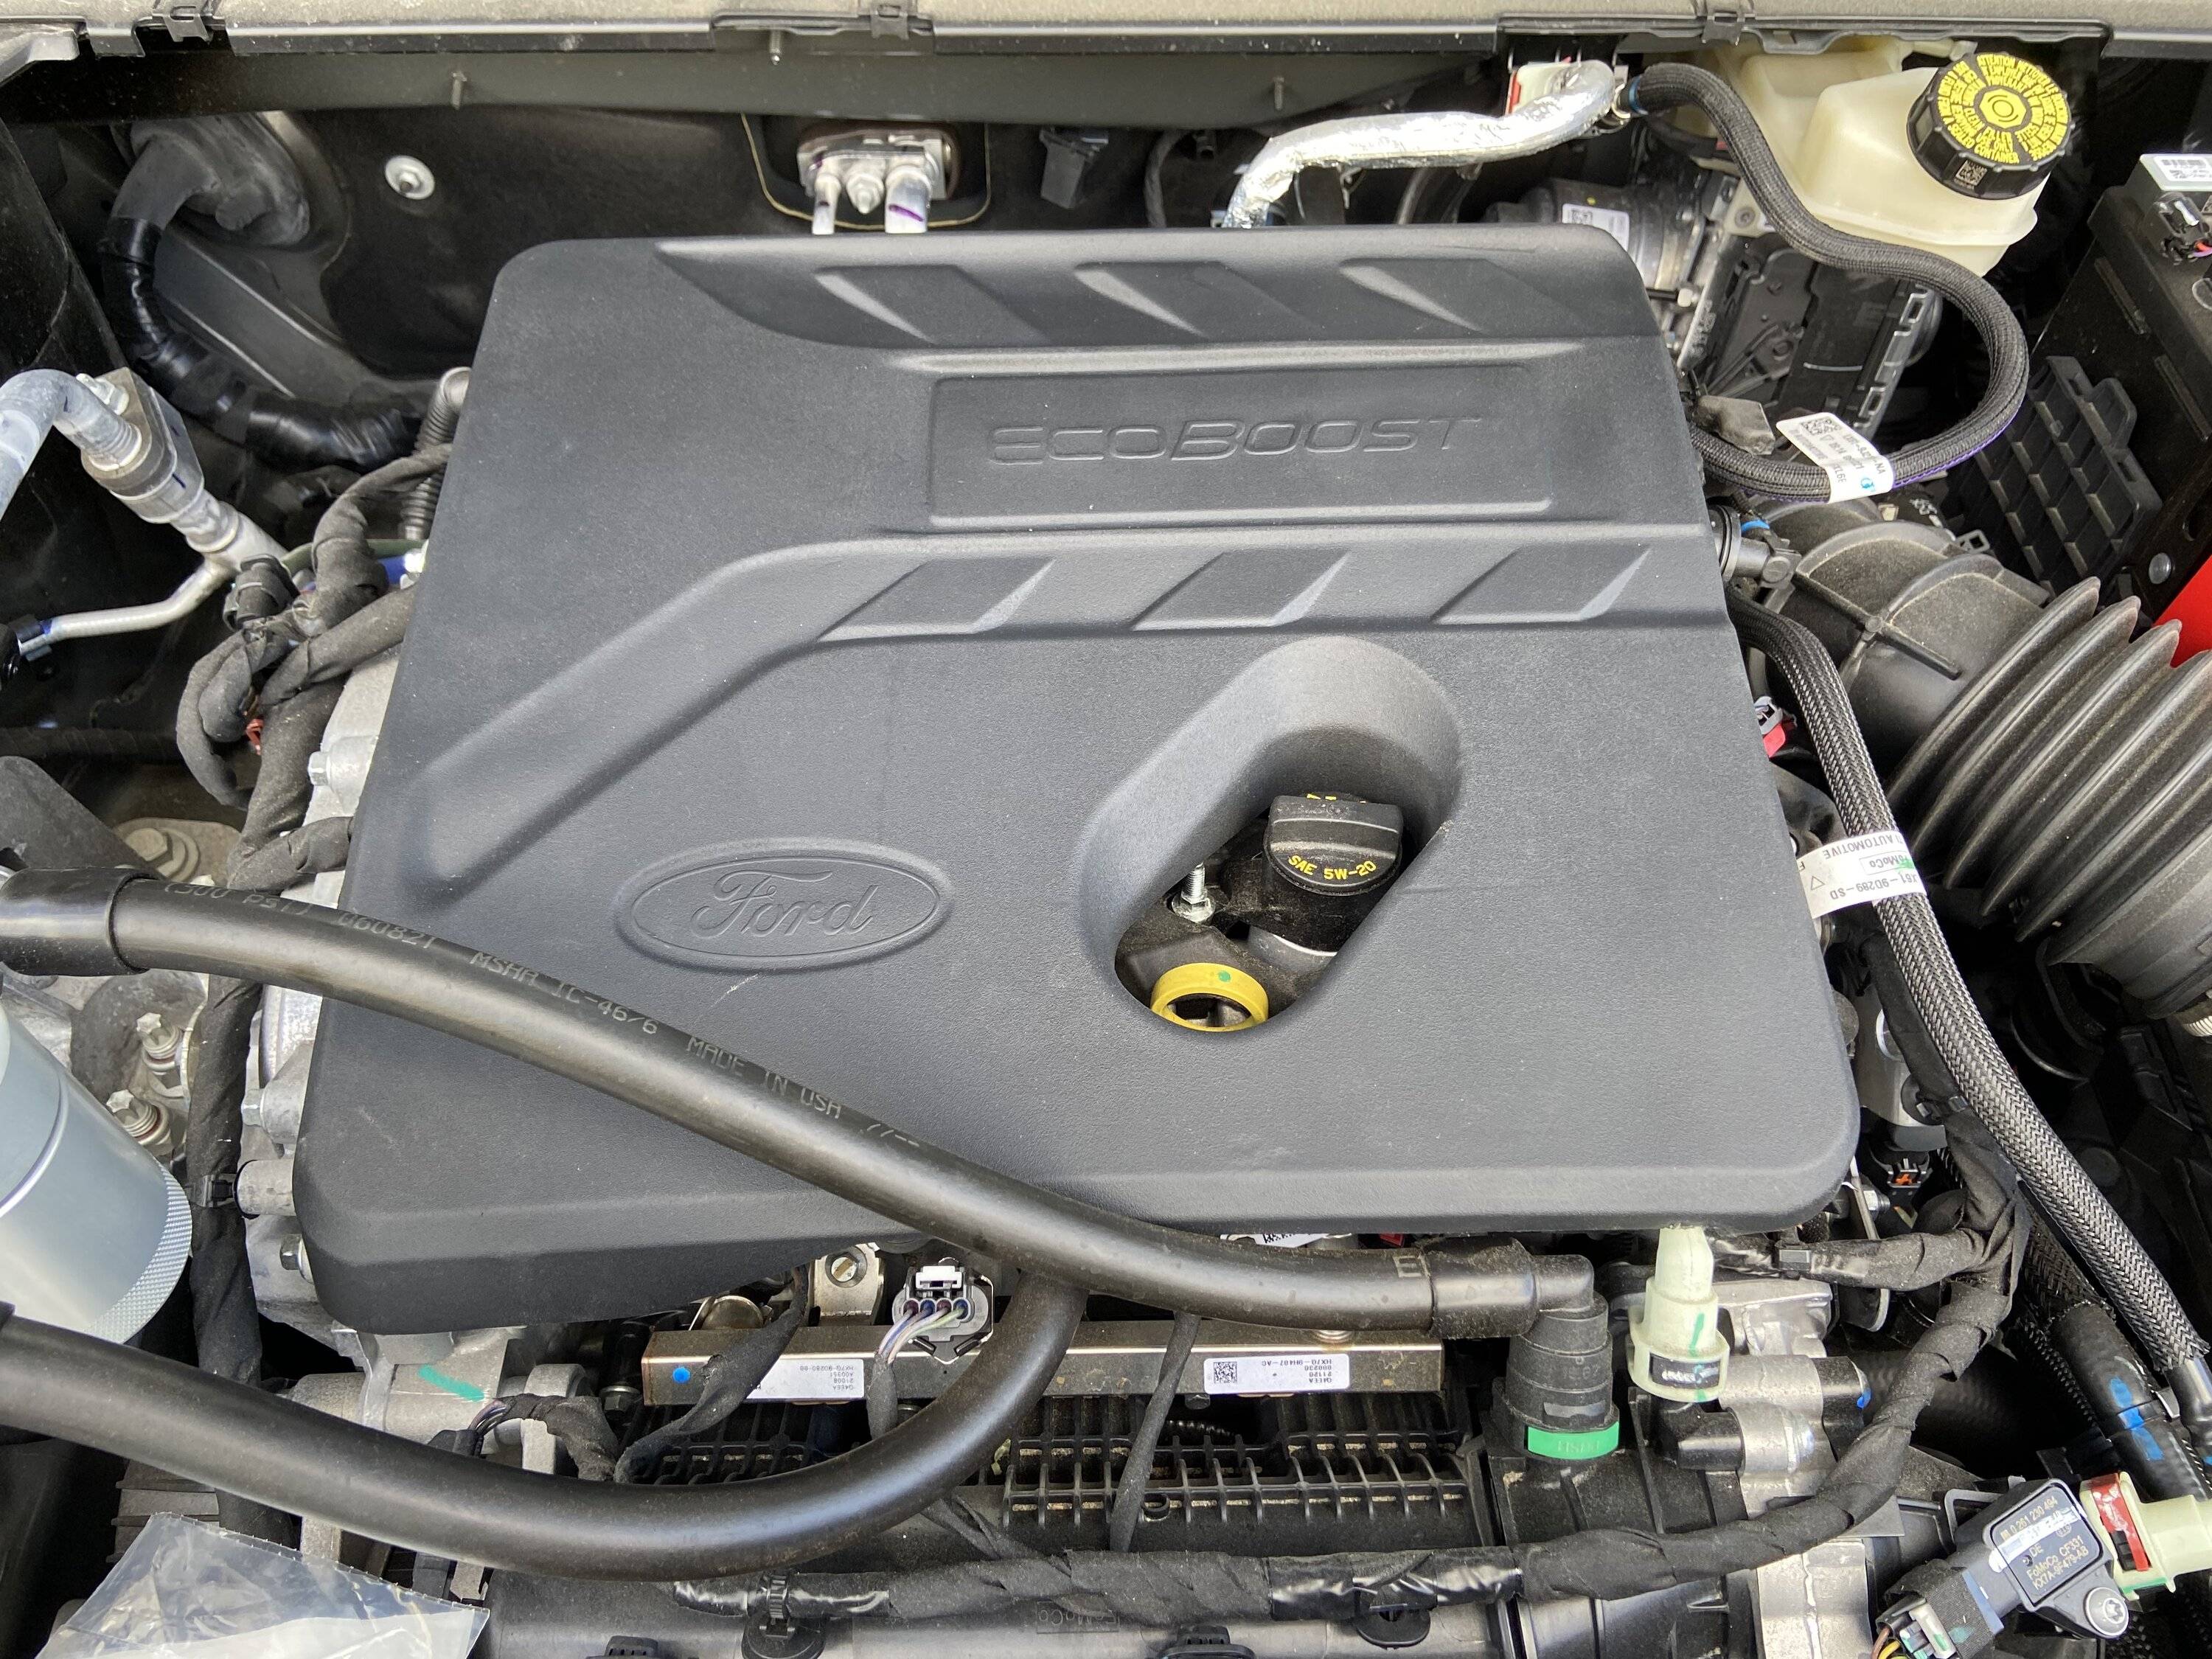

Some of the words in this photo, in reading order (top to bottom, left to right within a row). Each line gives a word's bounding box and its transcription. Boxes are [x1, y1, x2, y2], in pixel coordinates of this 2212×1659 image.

[987, 417, 1481, 466] ECOBOOST
[1822, 835, 1893, 860] AUTOMOTIVE
[1288, 855, 1318, 876] SAE
[1324, 860, 1377, 880] 5W-20
[690, 869, 879, 939] Ford
[336, 911, 437, 949] 060821
[470, 951, 539, 987] MSHA
[686, 1037, 745, 1077] MADE
[764, 1071, 788, 1096] IN
[801, 1087, 843, 1119] USA
[2011, 1523, 2017, 1533] 0
[2029, 1544, 2044, 1558] DE
[2026, 1554, 2059, 1580] FoMoCo
